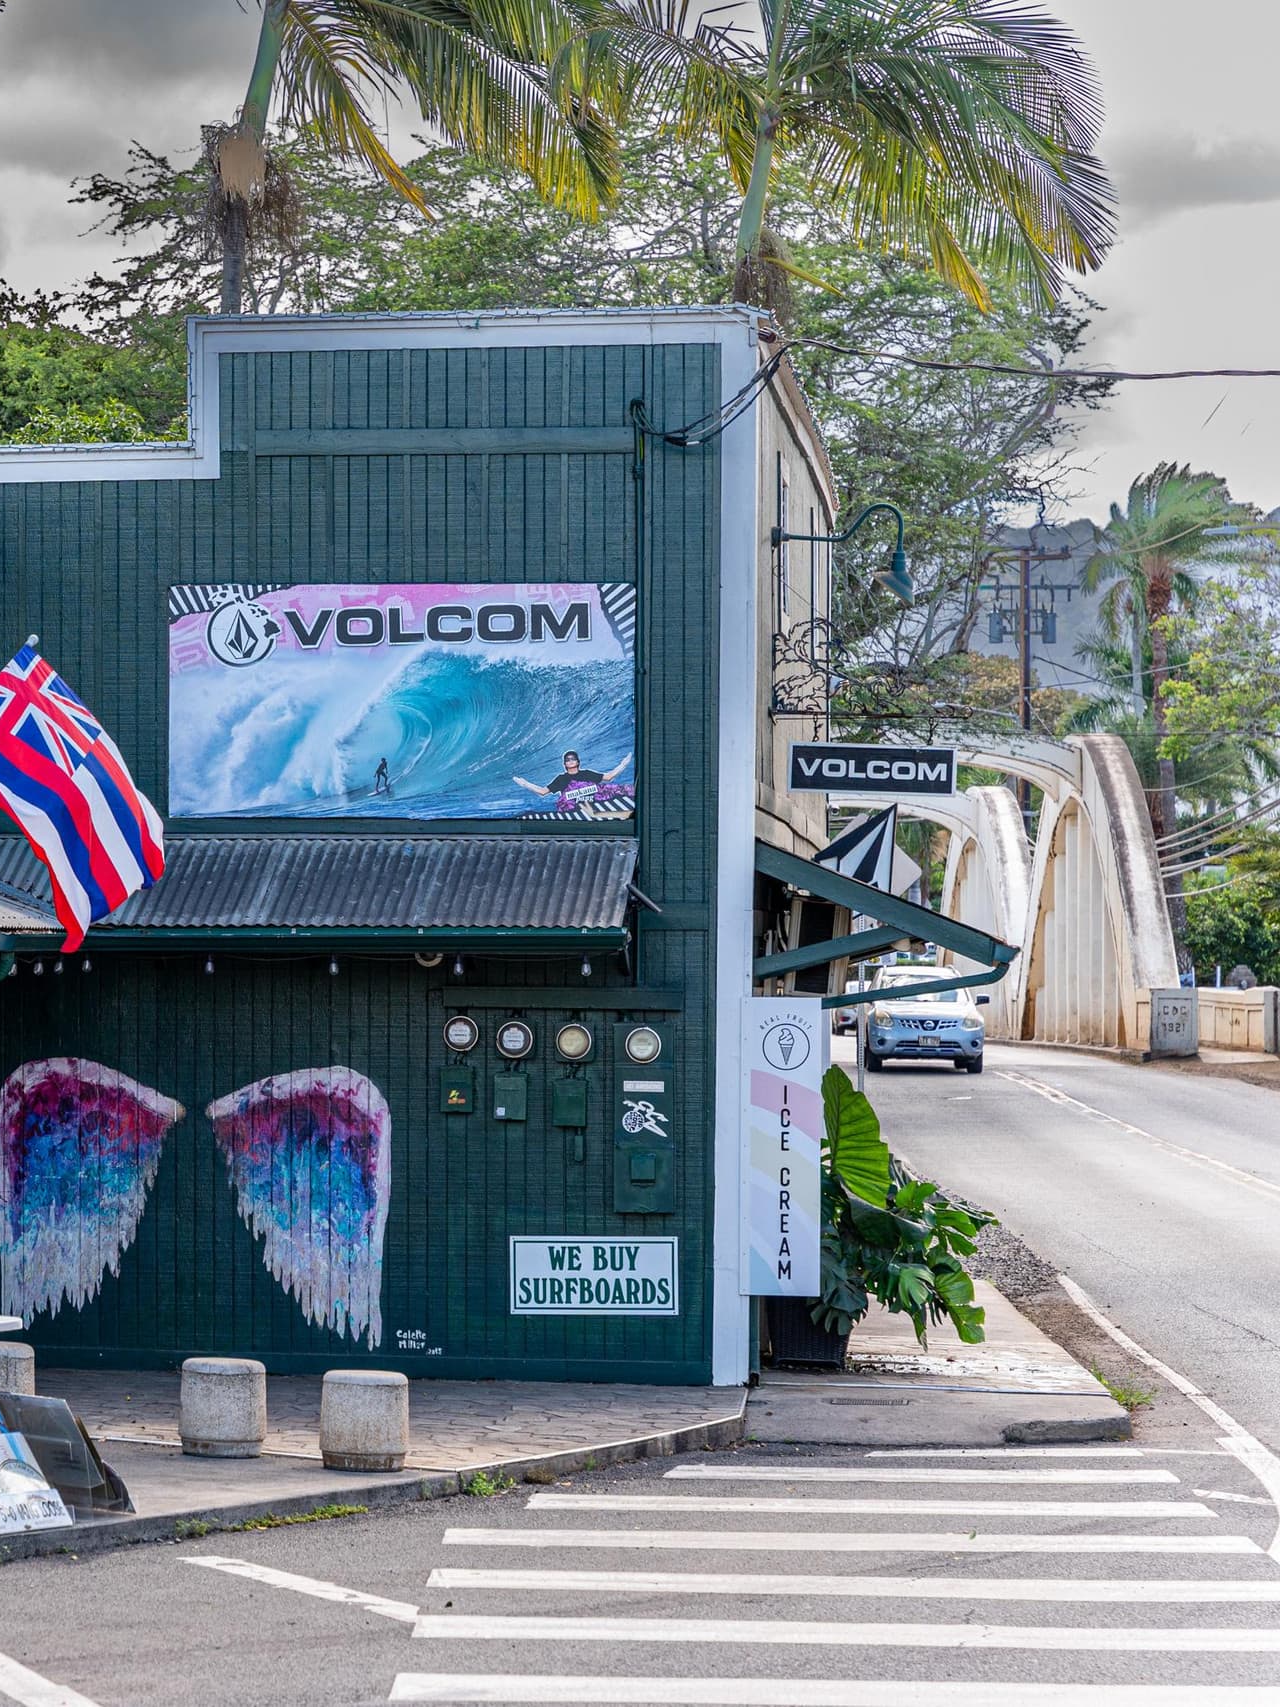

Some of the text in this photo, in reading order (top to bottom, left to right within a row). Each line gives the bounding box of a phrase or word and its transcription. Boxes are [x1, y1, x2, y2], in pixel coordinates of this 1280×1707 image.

[284, 601, 592, 650] VOLCOM
[797, 757, 948, 782] VOLCOM
[778, 1085, 792, 1280] ICE CREAM
[547, 1246, 640, 1271] WE BUY
[519, 1277, 671, 1305] SURFBOARDS
